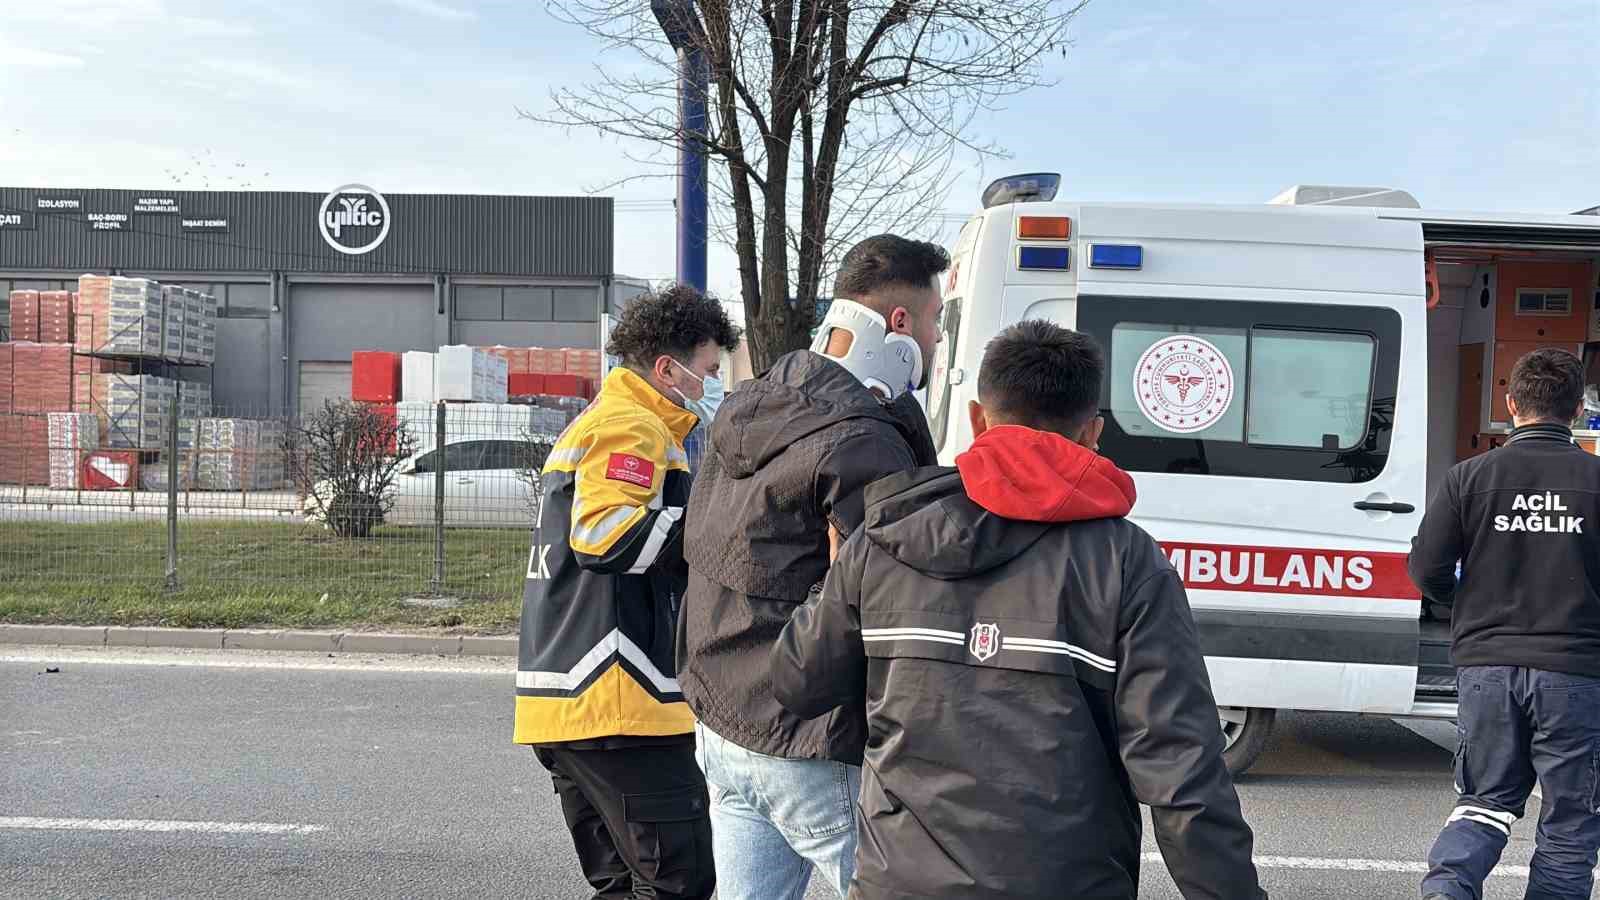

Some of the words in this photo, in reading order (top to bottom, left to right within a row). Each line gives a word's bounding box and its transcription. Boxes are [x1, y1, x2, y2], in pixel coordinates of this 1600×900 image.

[38, 198, 79, 208] İZOLASYON
[1512, 490, 1568, 511] ACİL
[1494, 512, 1584, 534] SAĞLIK
[1161, 547, 1373, 591] MBULANS
